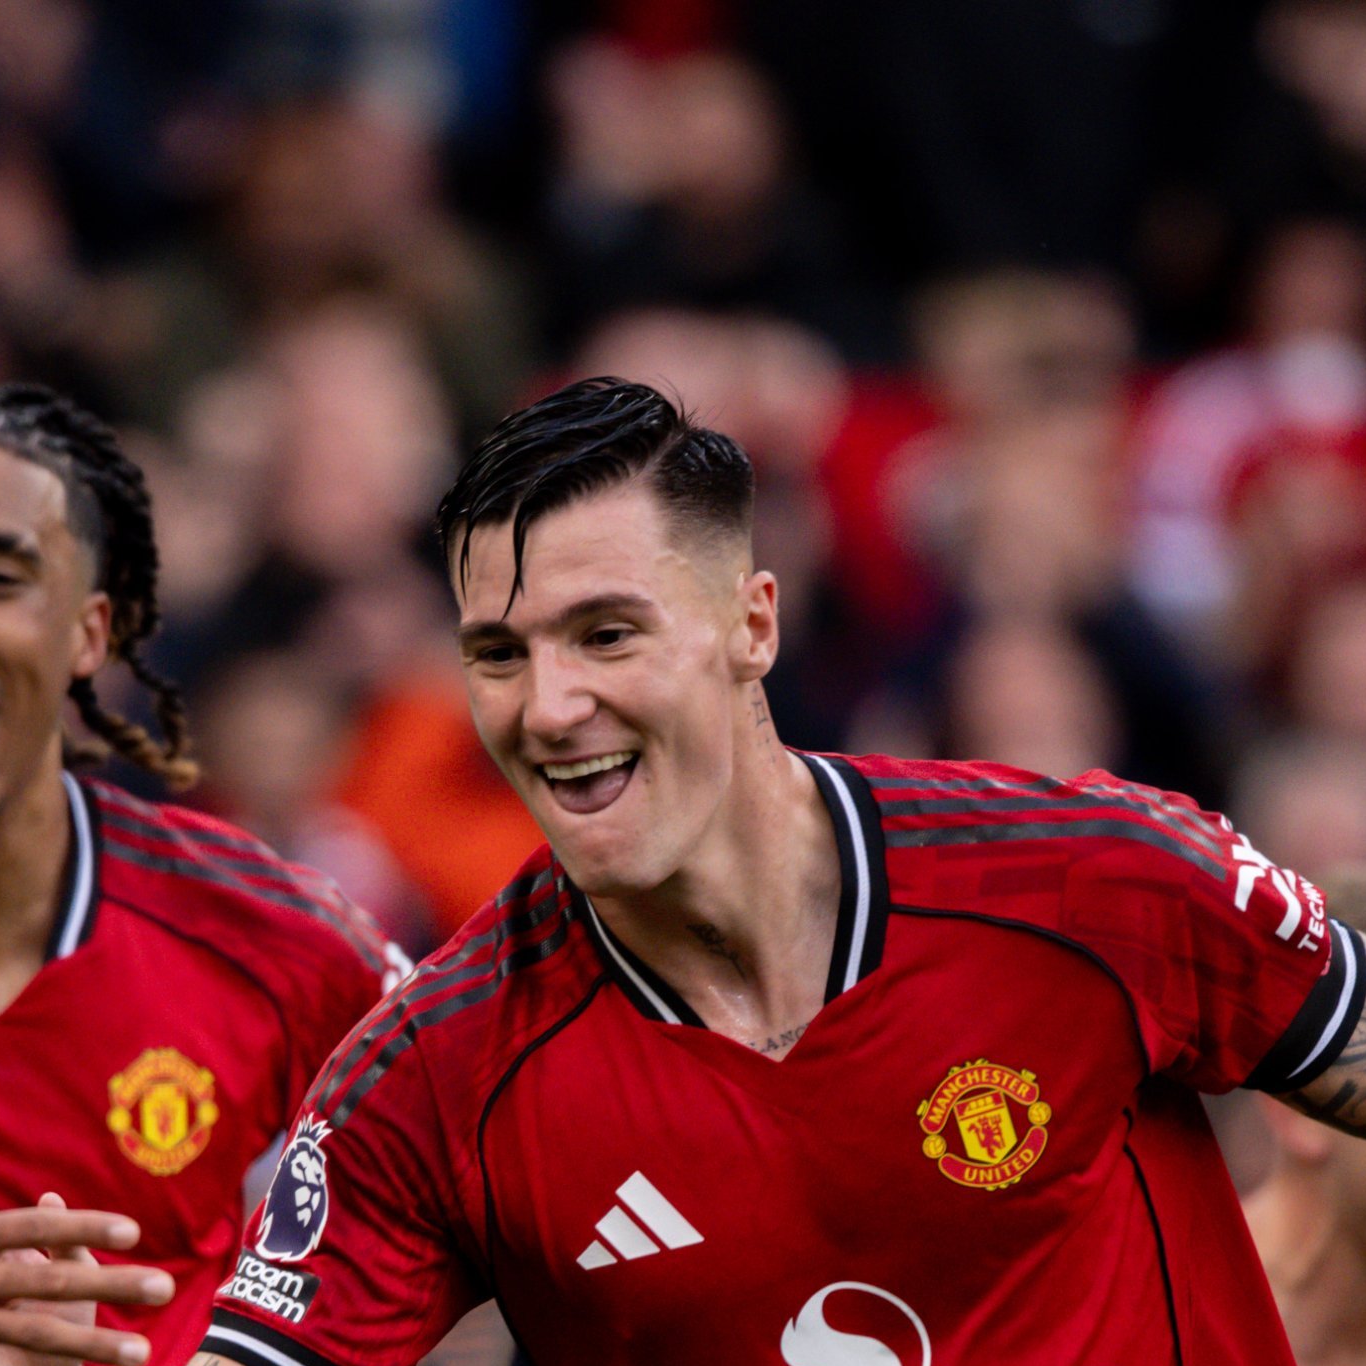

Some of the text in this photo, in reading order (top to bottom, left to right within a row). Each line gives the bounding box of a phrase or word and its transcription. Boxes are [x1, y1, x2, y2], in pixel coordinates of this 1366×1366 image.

[928, 1069, 1031, 1124] MANCHESTER
[964, 1148, 1034, 1183] UNITED
[232, 1276, 306, 1323] racism
[237, 1255, 304, 1299] room
